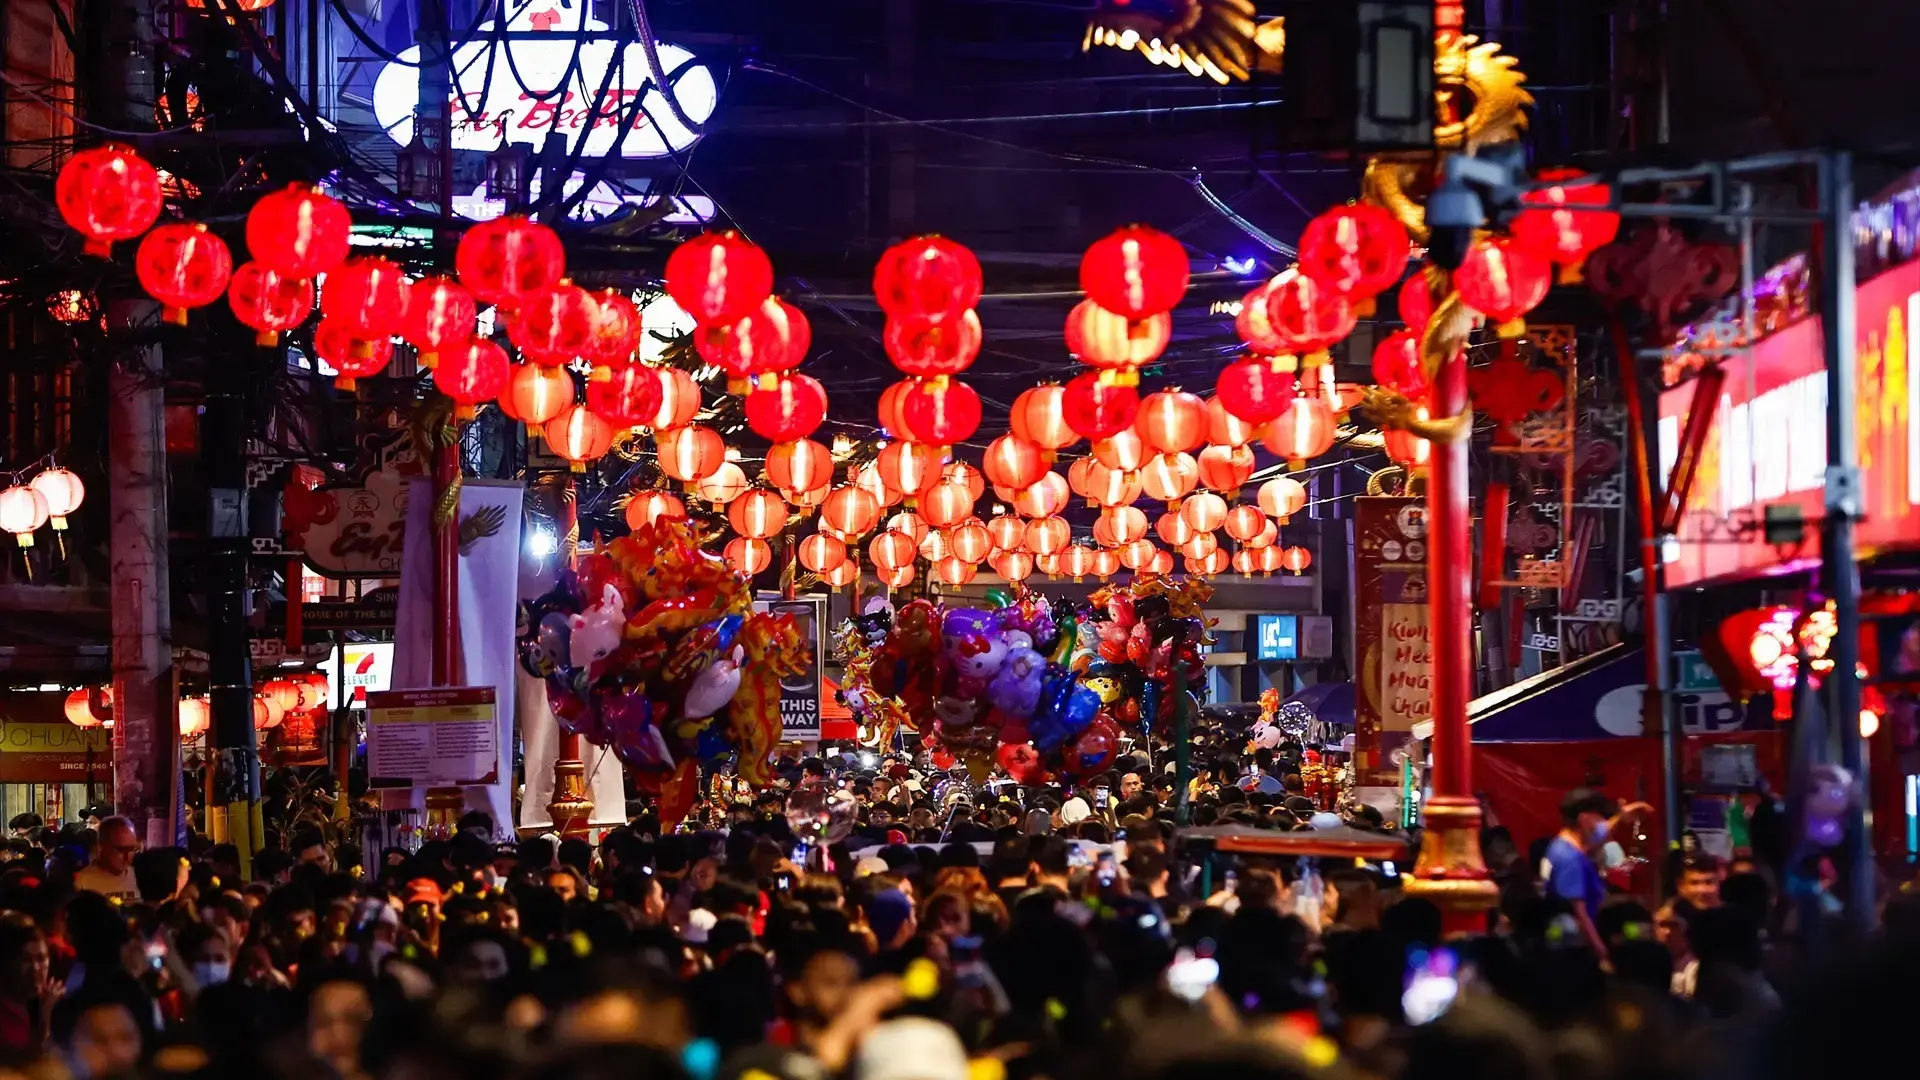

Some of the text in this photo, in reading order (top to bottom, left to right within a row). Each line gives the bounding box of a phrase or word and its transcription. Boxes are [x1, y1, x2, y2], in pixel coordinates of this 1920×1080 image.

[376, 592, 400, 602] SINC
[354, 610, 377, 619] THE
[779, 699, 816, 711] THIS
[781, 713, 817, 725] WAY
[10, 727, 99, 747] CHUAN
[60, 762, 84, 770] SINCE
